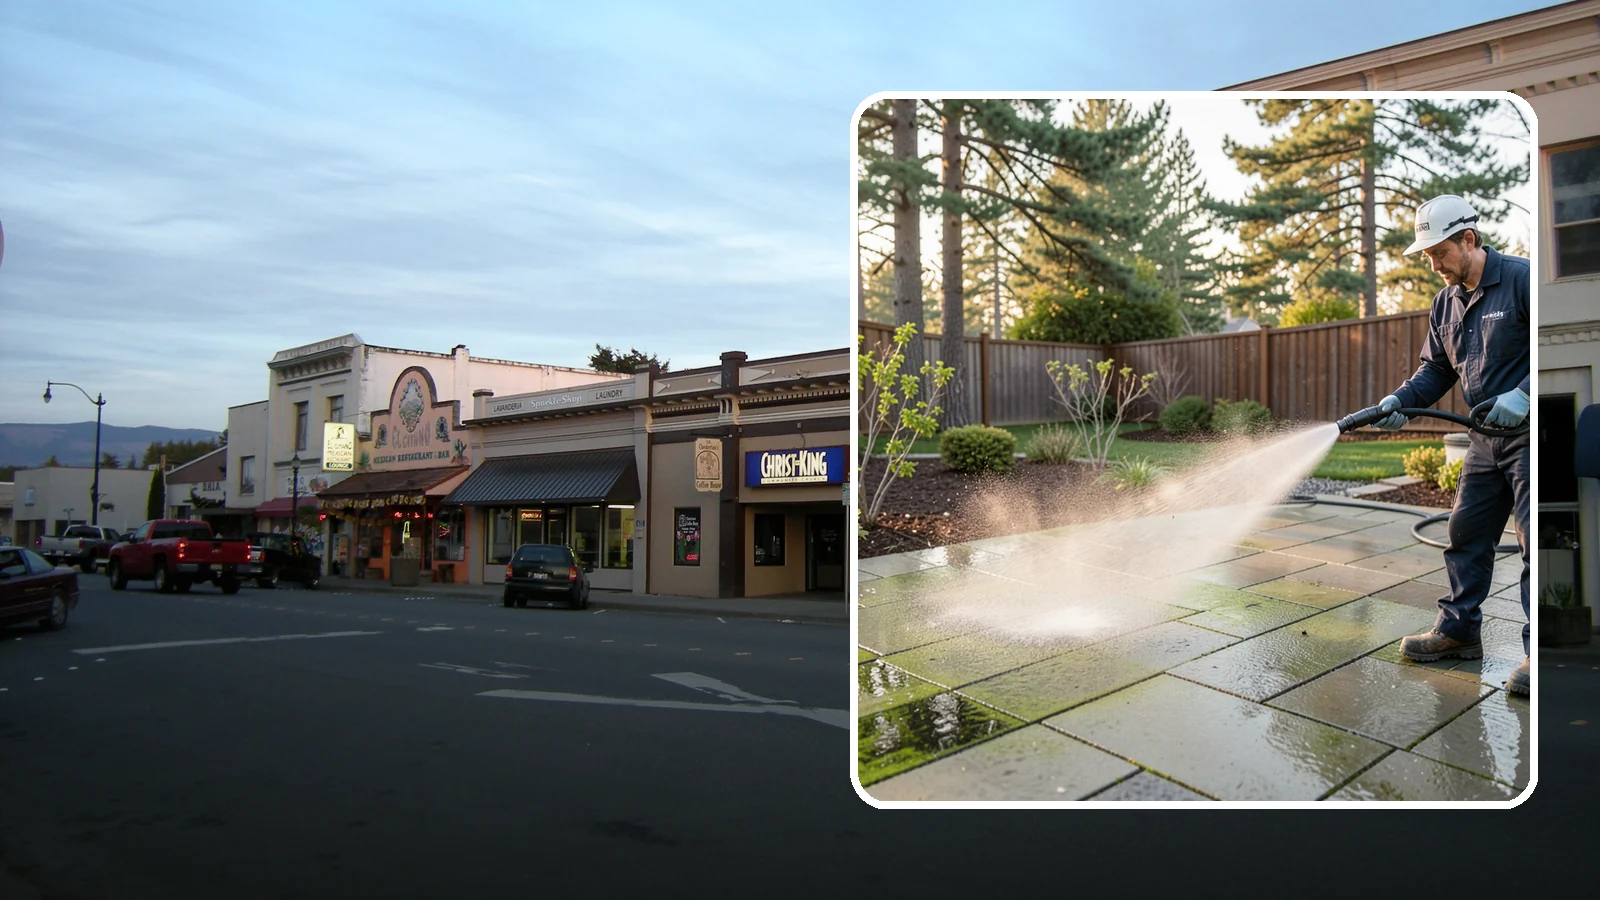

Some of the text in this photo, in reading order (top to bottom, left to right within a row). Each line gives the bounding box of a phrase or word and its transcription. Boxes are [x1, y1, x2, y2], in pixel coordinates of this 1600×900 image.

[595, 389, 624, 400] LAUNDRY
[493, 402, 522, 412] LAVANDERIA
[373, 455, 396, 464] MEXICAN
[397, 451, 433, 462] RESTAURANT
[438, 450, 450, 459] BAR
[761, 450, 827, 478] CHRIST KING
